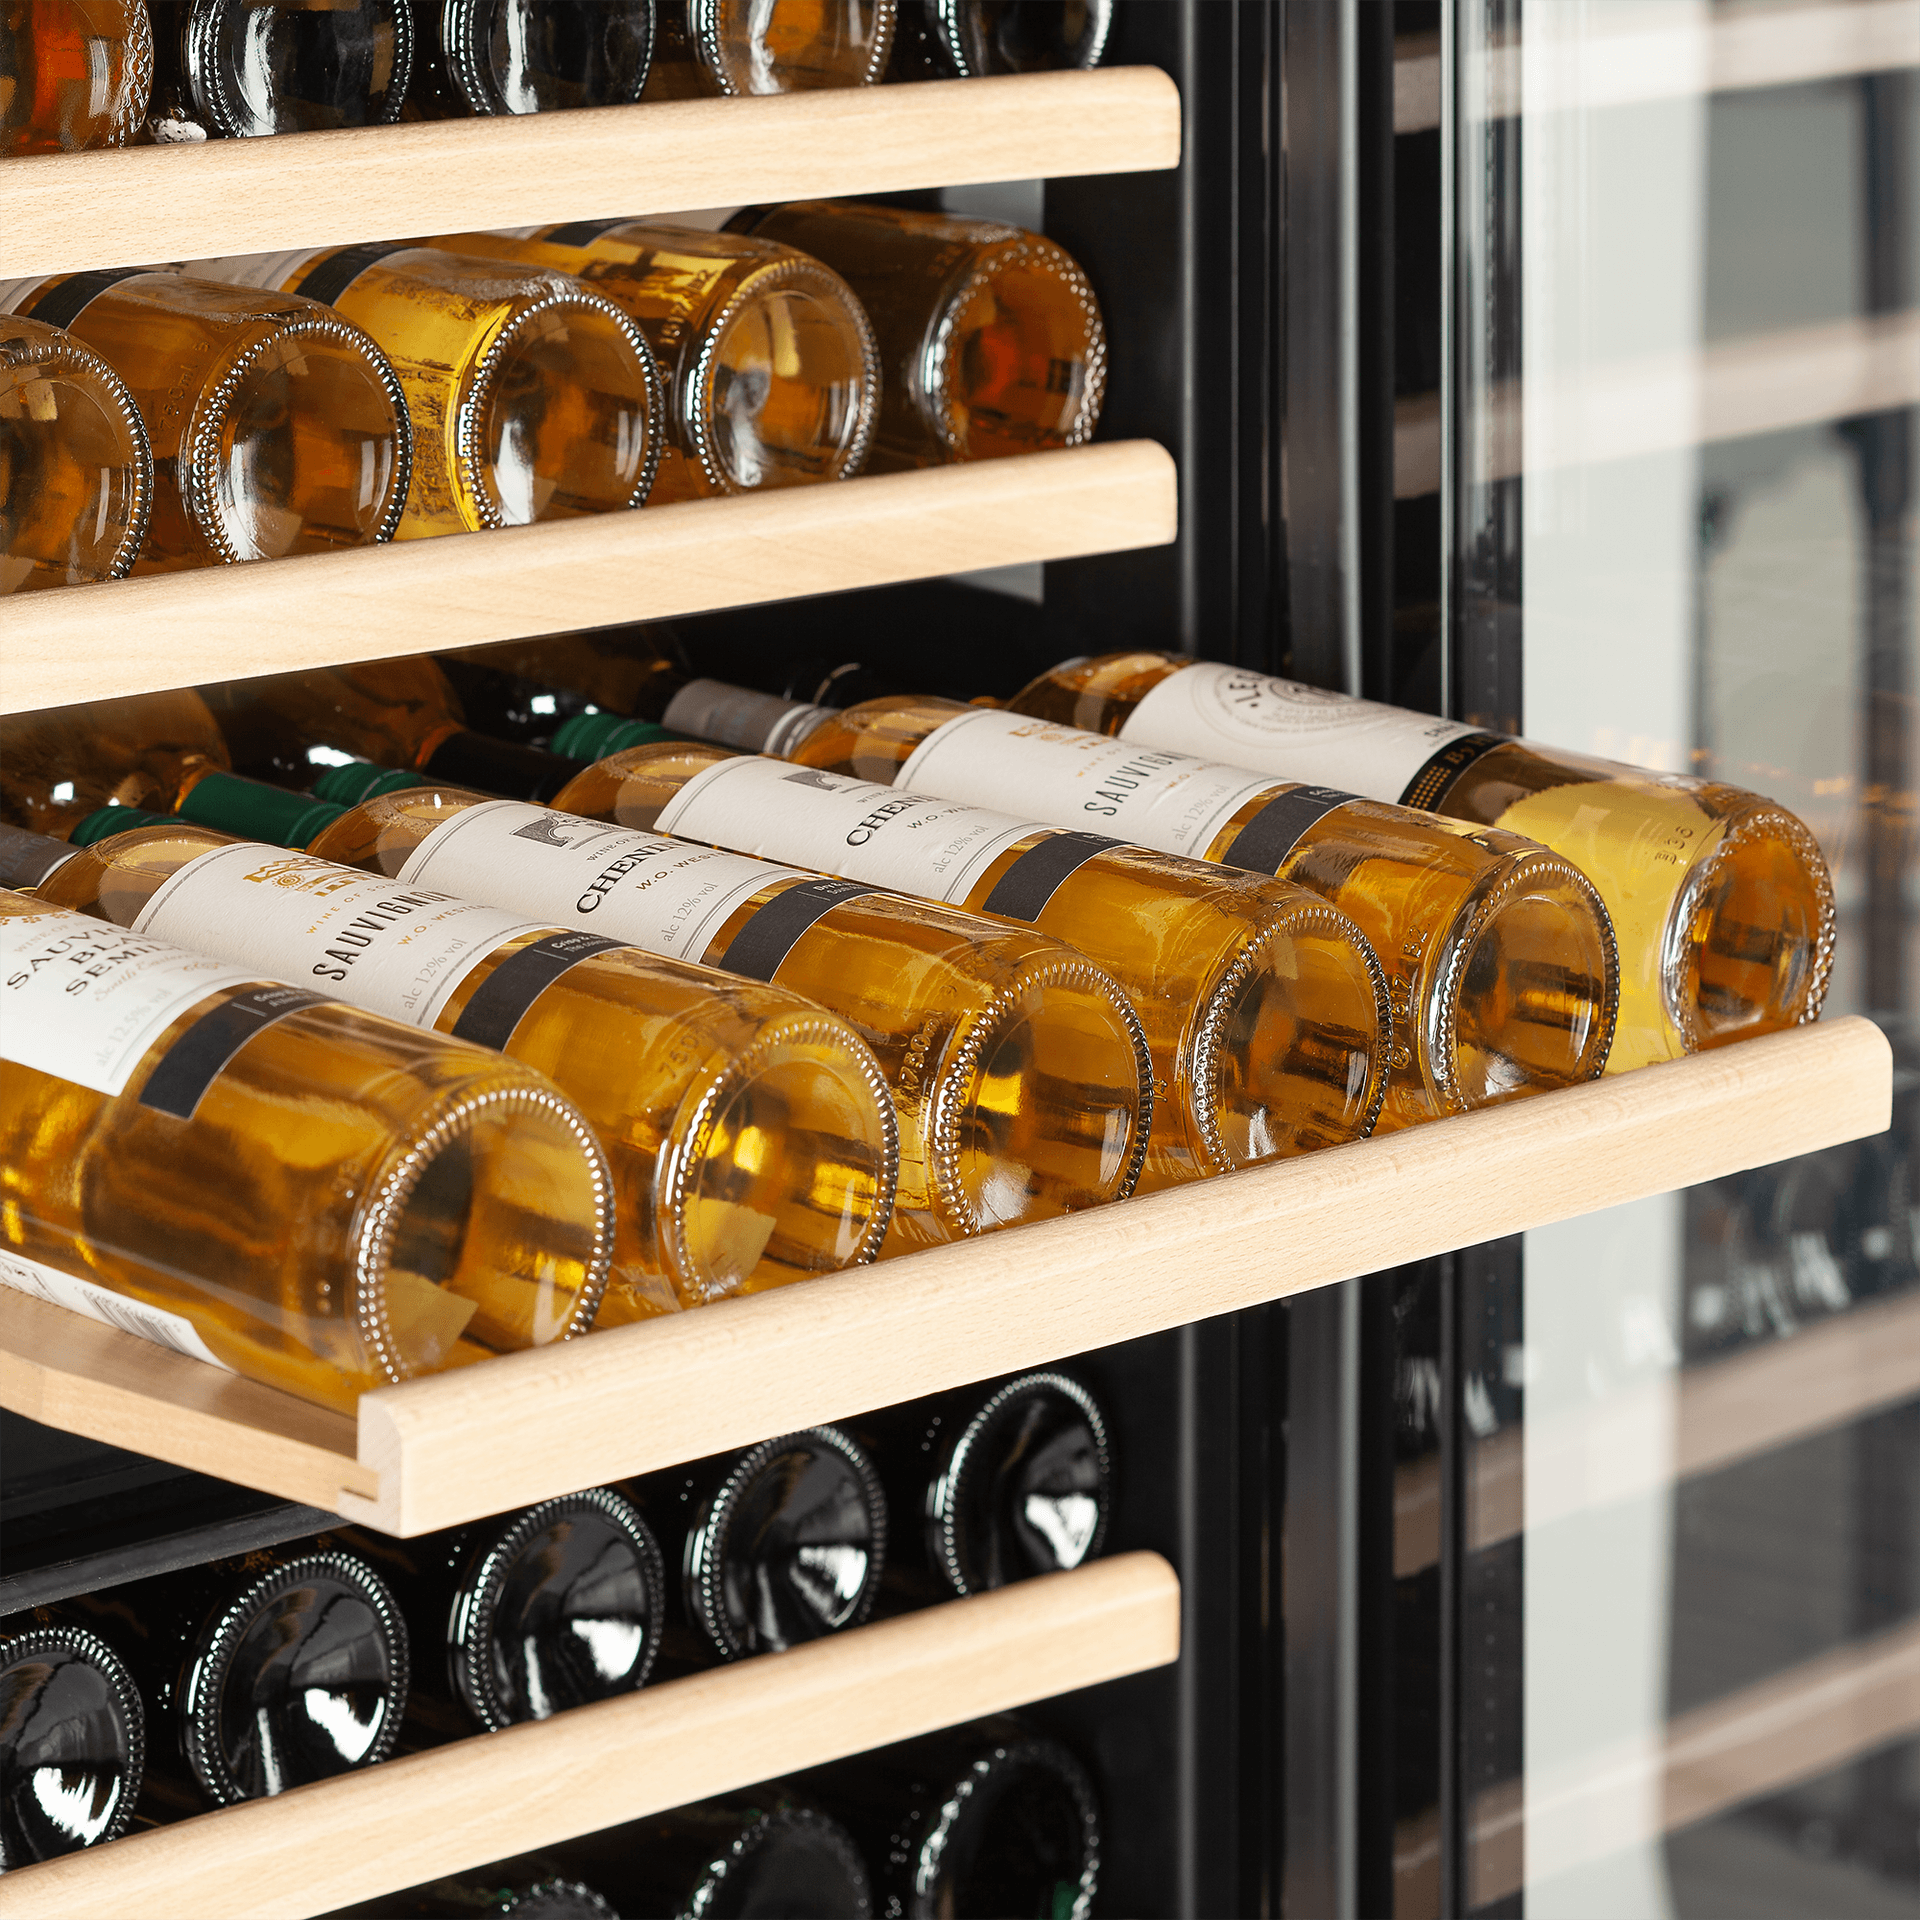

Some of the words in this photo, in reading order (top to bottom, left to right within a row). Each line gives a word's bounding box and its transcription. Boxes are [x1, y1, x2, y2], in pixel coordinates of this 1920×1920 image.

[1174, 821, 1193, 841] alc
[1187, 797, 1214, 822] 12%
[1210, 784, 1230, 800] vol
[932, 857, 950, 875] alc
[943, 833, 974, 858] 12%
[967, 824, 990, 838] vol
[306, 906, 341, 935] WINE
[343, 892, 362, 903] OF
[661, 923, 680, 943] alc
[675, 895, 701, 923] 12%
[698, 881, 720, 898] vol
[402, 990, 421, 1010] alc
[416, 952, 449, 984] 12%
[445, 938, 468, 955] vol
